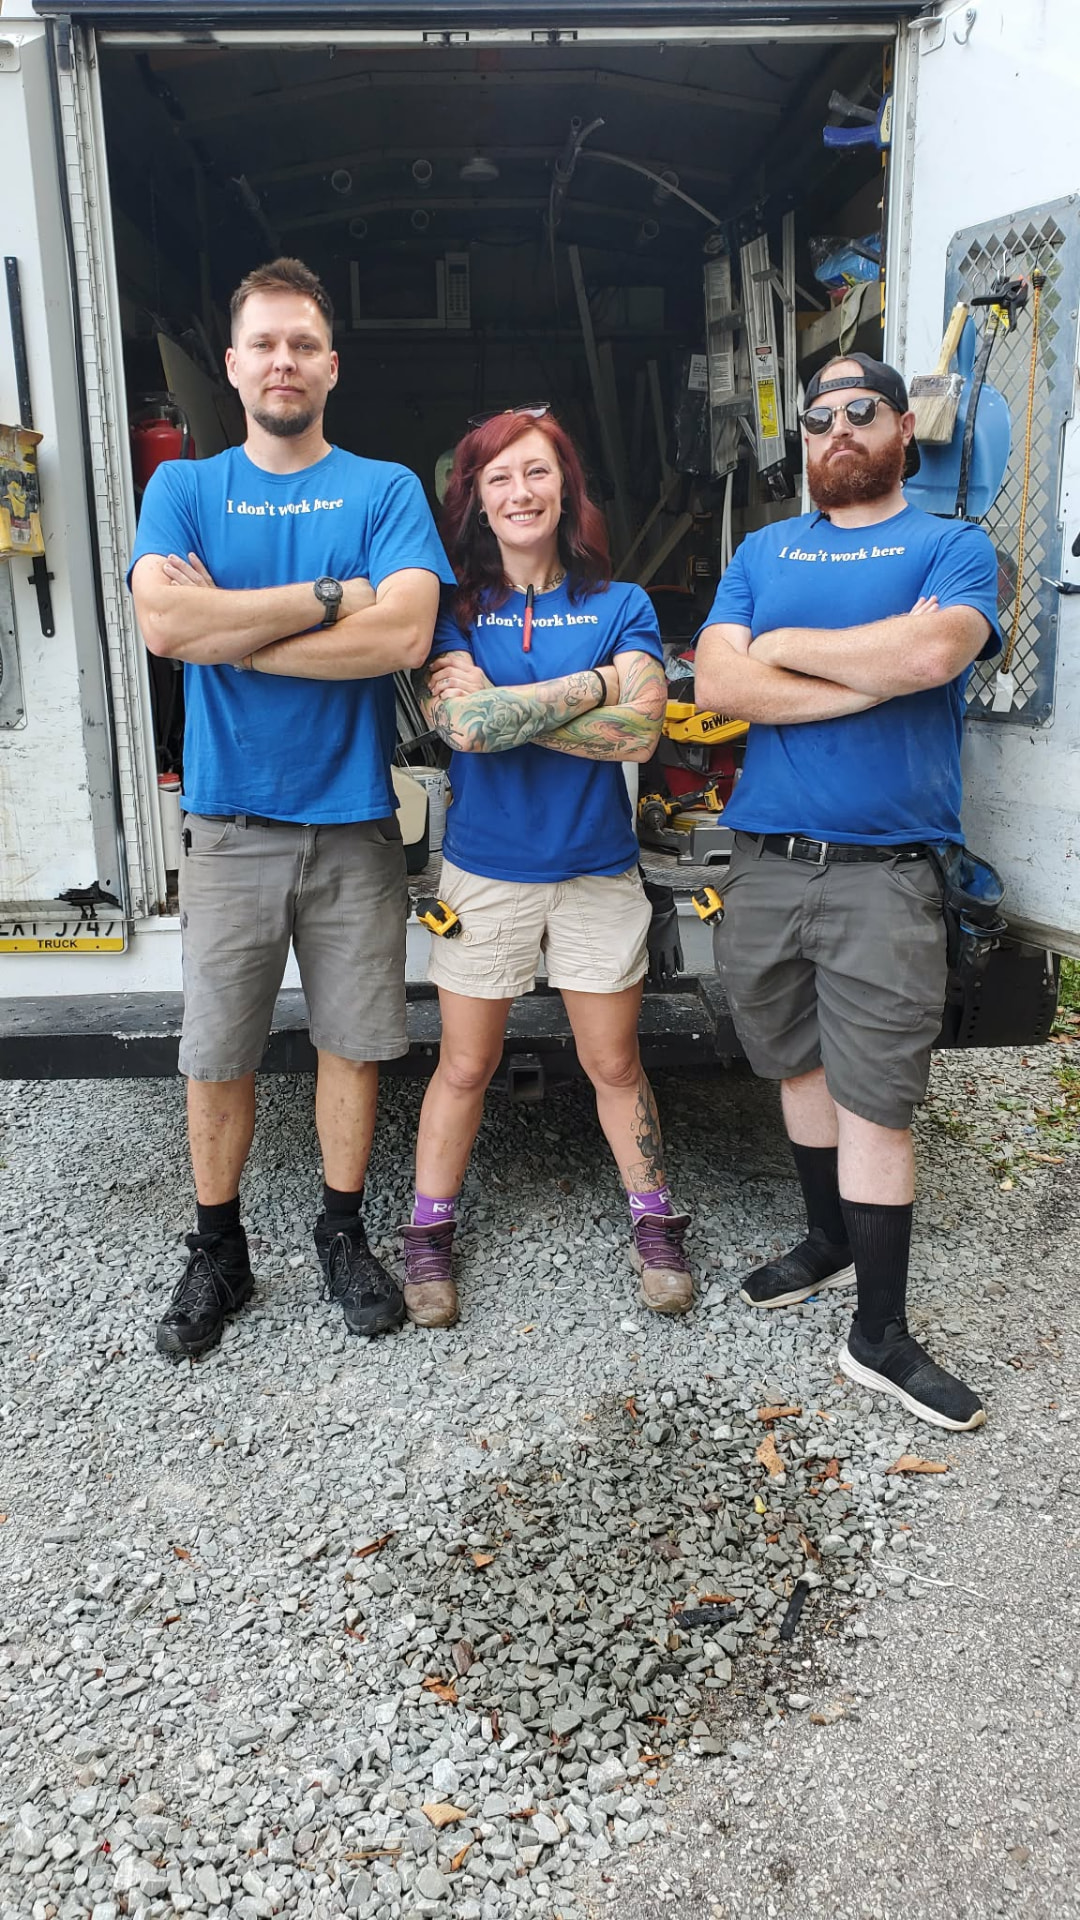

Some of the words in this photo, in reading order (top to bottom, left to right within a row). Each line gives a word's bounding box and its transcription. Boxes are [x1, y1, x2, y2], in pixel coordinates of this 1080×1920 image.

[227, 500, 233, 513] I
[237, 501, 275, 516] don't
[278, 500, 310, 516] work
[314, 499, 343, 511] here
[779, 547, 788, 558] I
[789, 549, 827, 562] don't
[831, 548, 868, 562] work
[871, 546, 905, 558] here
[477, 615, 483, 627] I
[486, 613, 523, 627] don't
[565, 613, 598, 625] here
[37, 939, 78, 948] TRUCK
